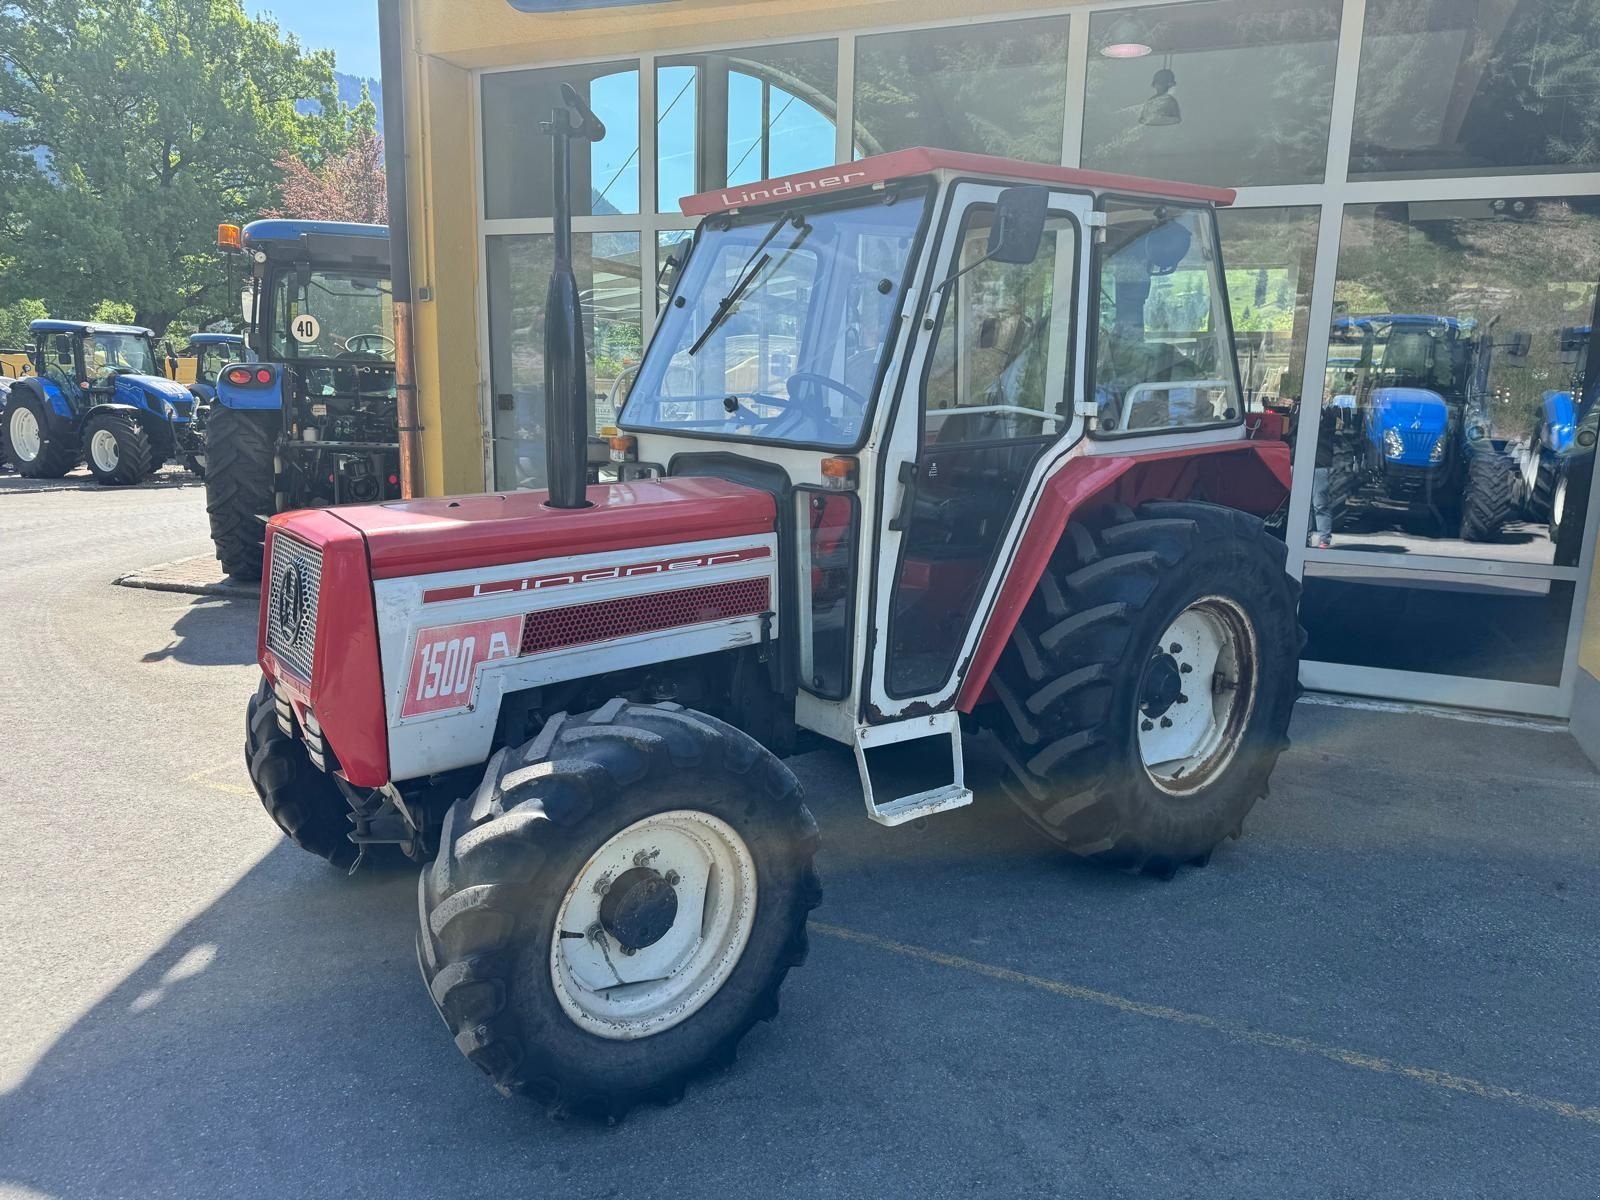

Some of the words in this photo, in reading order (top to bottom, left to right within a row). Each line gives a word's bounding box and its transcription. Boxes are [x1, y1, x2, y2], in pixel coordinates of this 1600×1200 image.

[722, 171, 865, 206] Lindner
[297, 320, 313, 337] 40
[473, 554, 740, 598] Lindner
[416, 636, 476, 701] 1500
[488, 631, 510, 659] A
